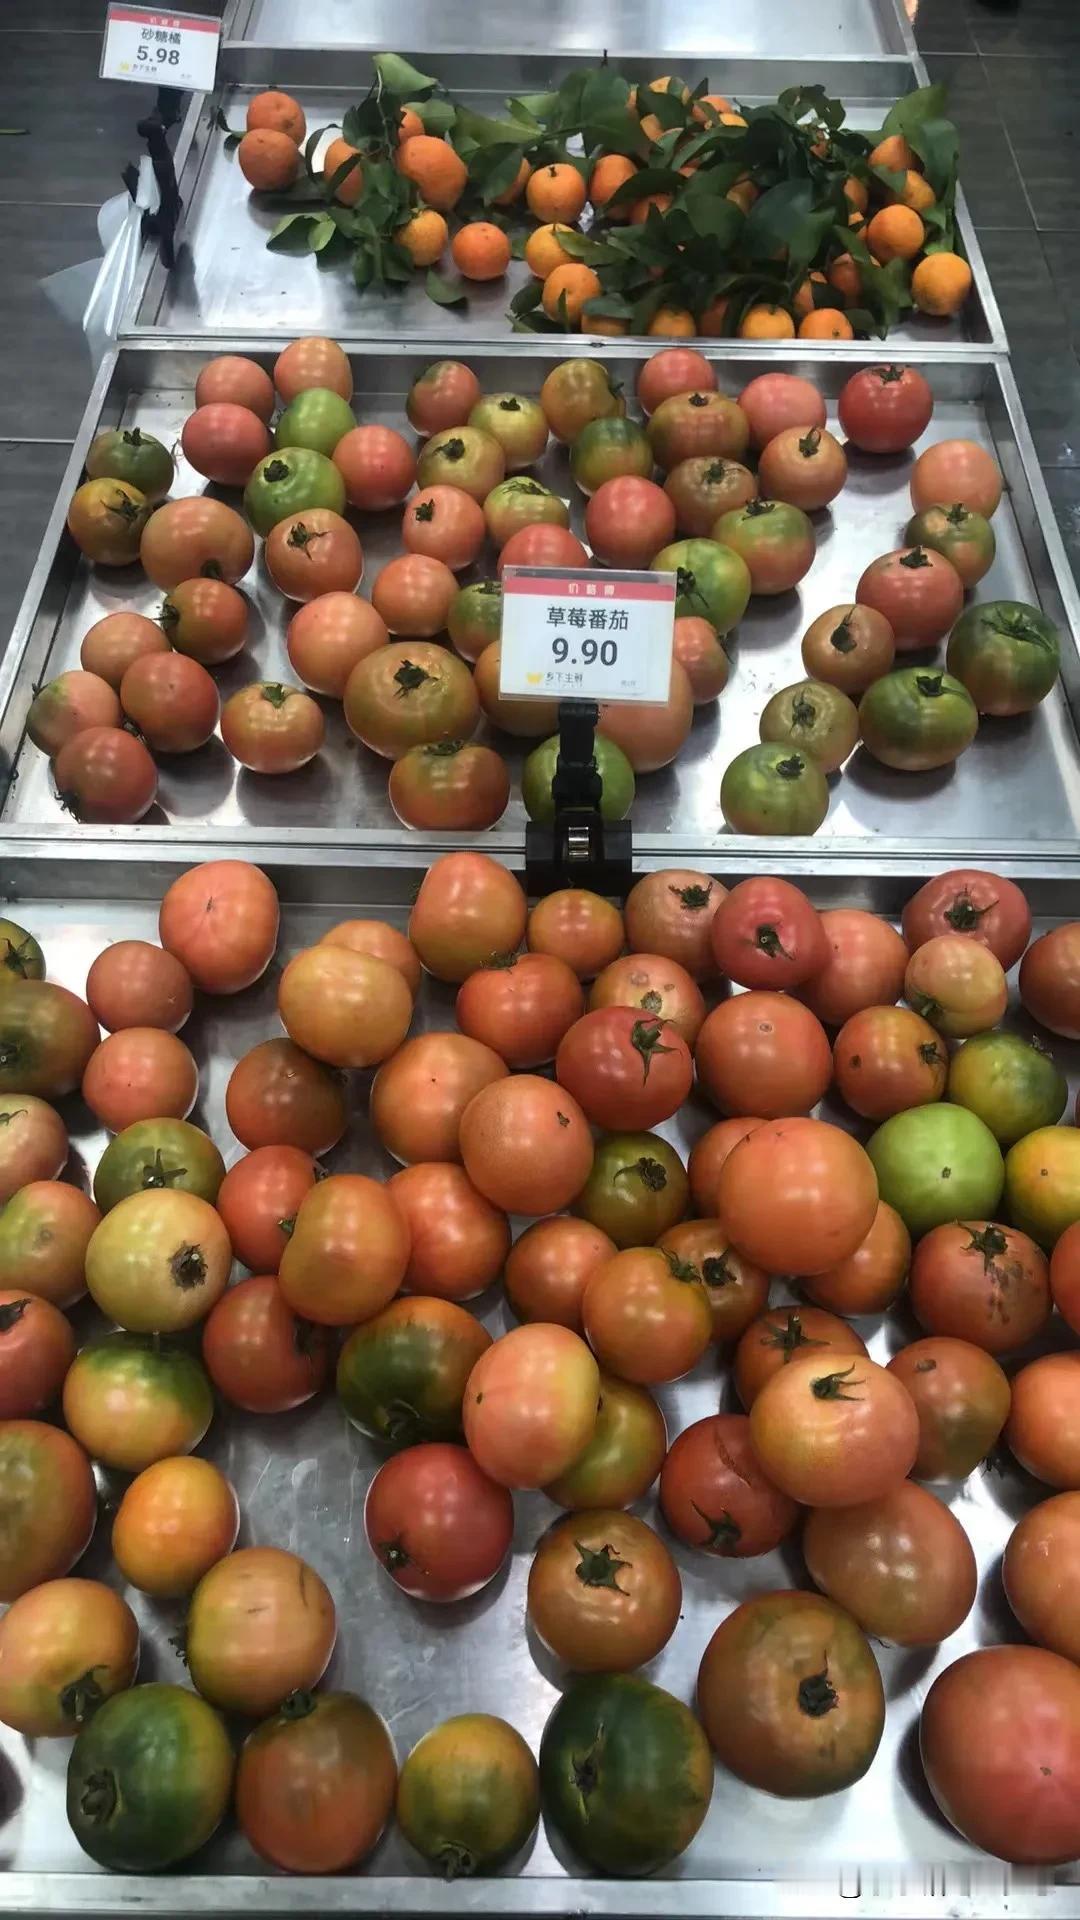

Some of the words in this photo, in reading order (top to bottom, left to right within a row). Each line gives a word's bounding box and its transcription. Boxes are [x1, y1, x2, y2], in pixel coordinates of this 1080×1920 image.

[141, 27, 182, 45] 砂糖橘
[136, 45, 181, 65] 5.98
[546, 606, 629, 631] 草莓番茄
[551, 637, 619, 666] 9.90
